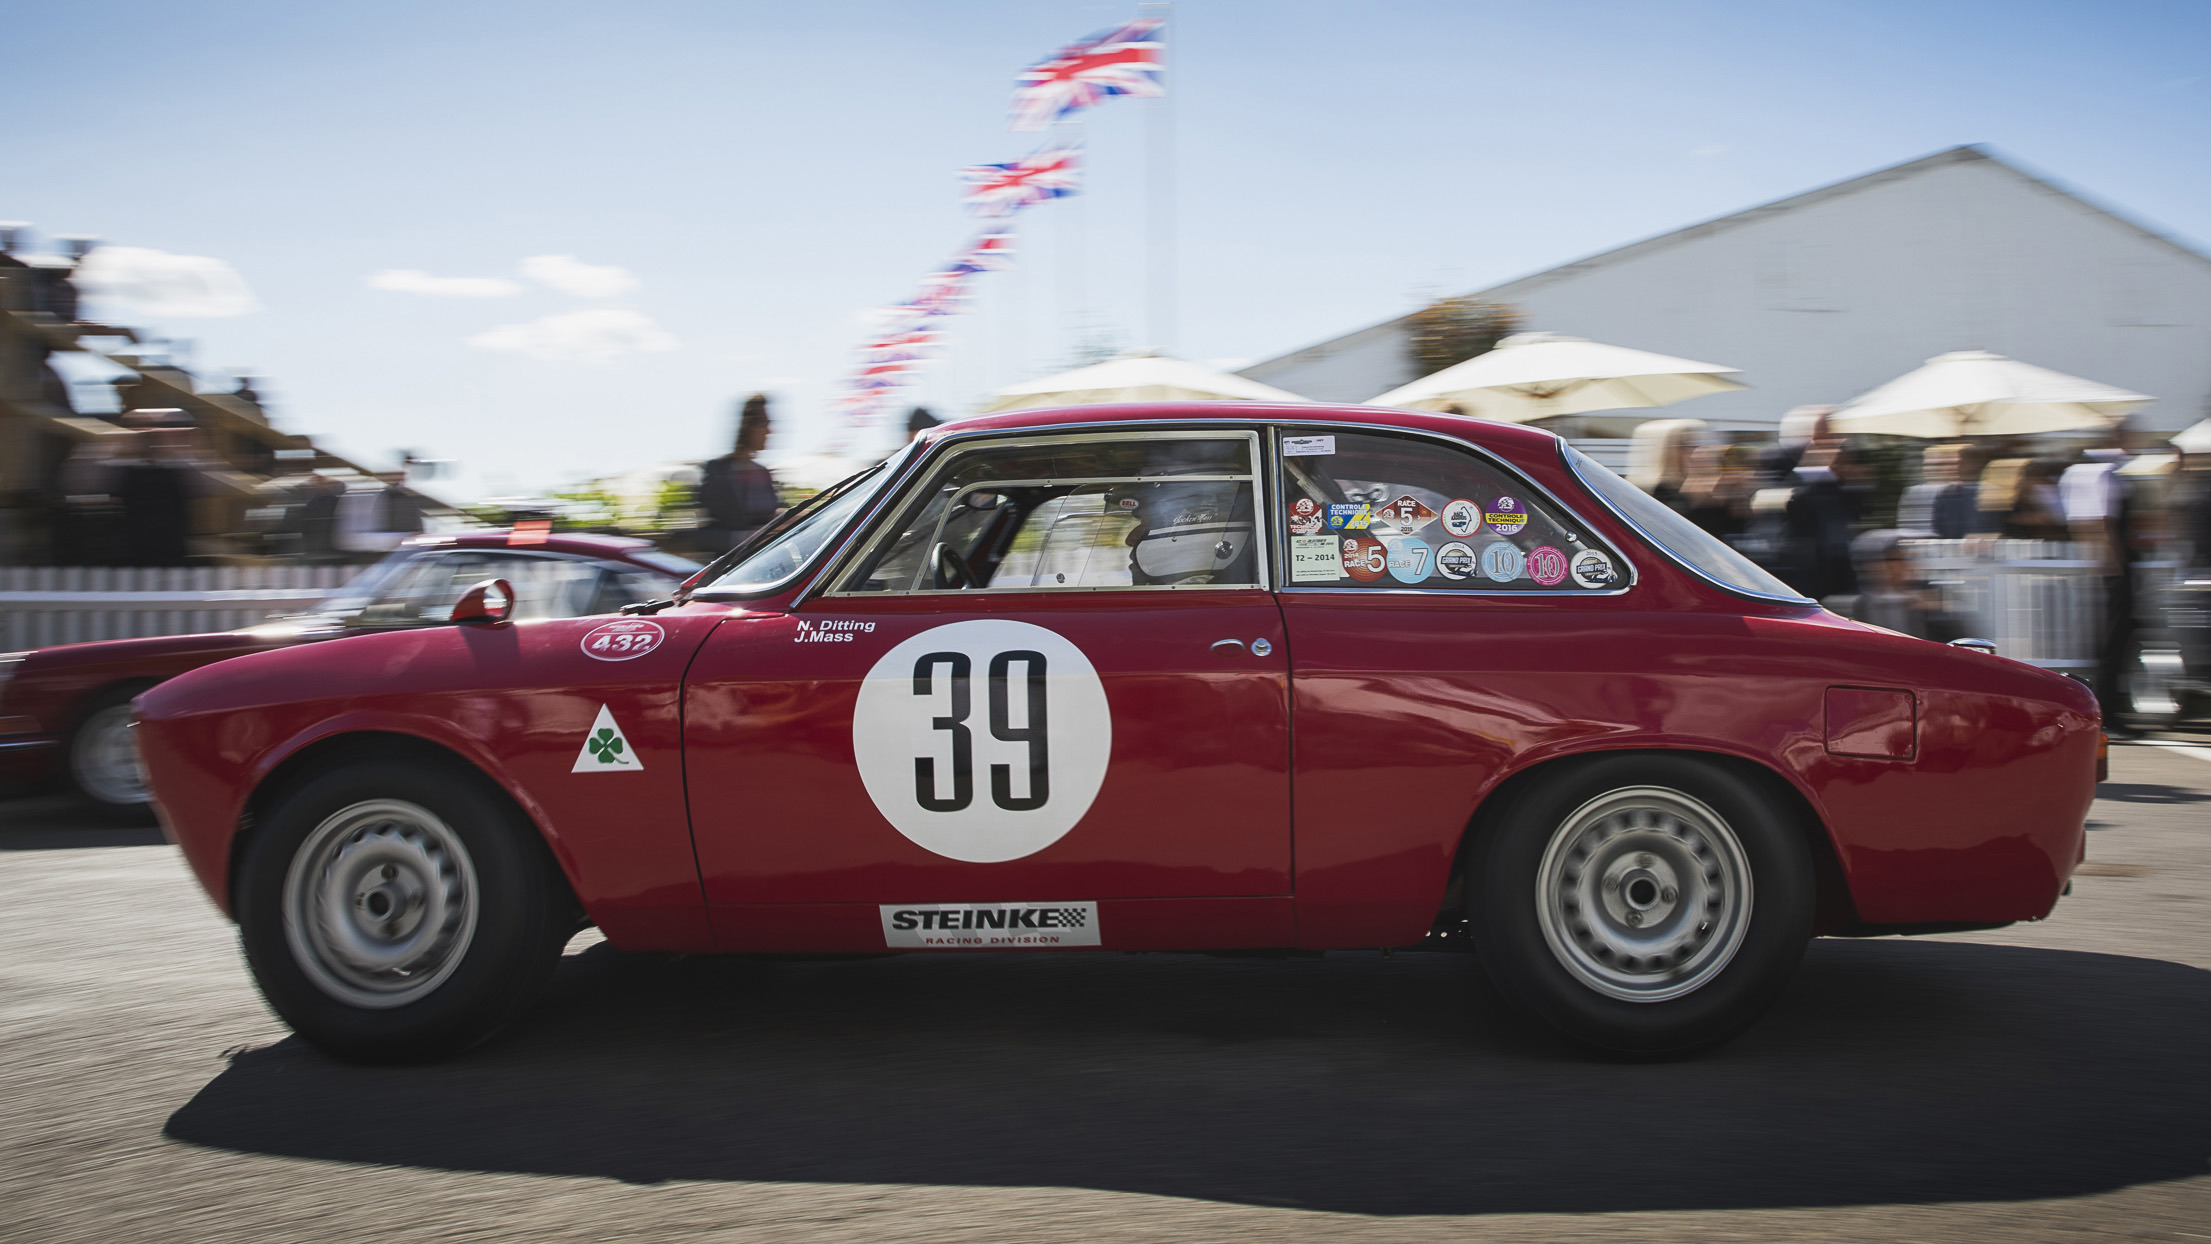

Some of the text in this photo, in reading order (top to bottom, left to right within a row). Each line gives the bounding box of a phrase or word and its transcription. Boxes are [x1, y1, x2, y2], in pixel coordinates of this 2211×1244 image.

[1400, 507, 1414, 526] 5
[1495, 524, 1518, 532] 2016
[1295, 554, 1305, 562] T2
[1344, 560, 1366, 568] RACE
[1367, 545, 1386, 573] 5
[1389, 560, 1411, 568] RACE
[1412, 547, 1429, 576] 7
[1491, 550, 1515, 575] 10
[1535, 553, 1561, 578] 10
[1578, 564, 1594, 572] GRAND
[796, 620, 876, 633] N. Ditting
[591, 634, 654, 652] 432
[793, 631, 854, 643] J.Mass
[912, 650, 1050, 813] 39
[892, 908, 1059, 930] STEINKE
[926, 936, 1060, 945] RACING DIVISION
